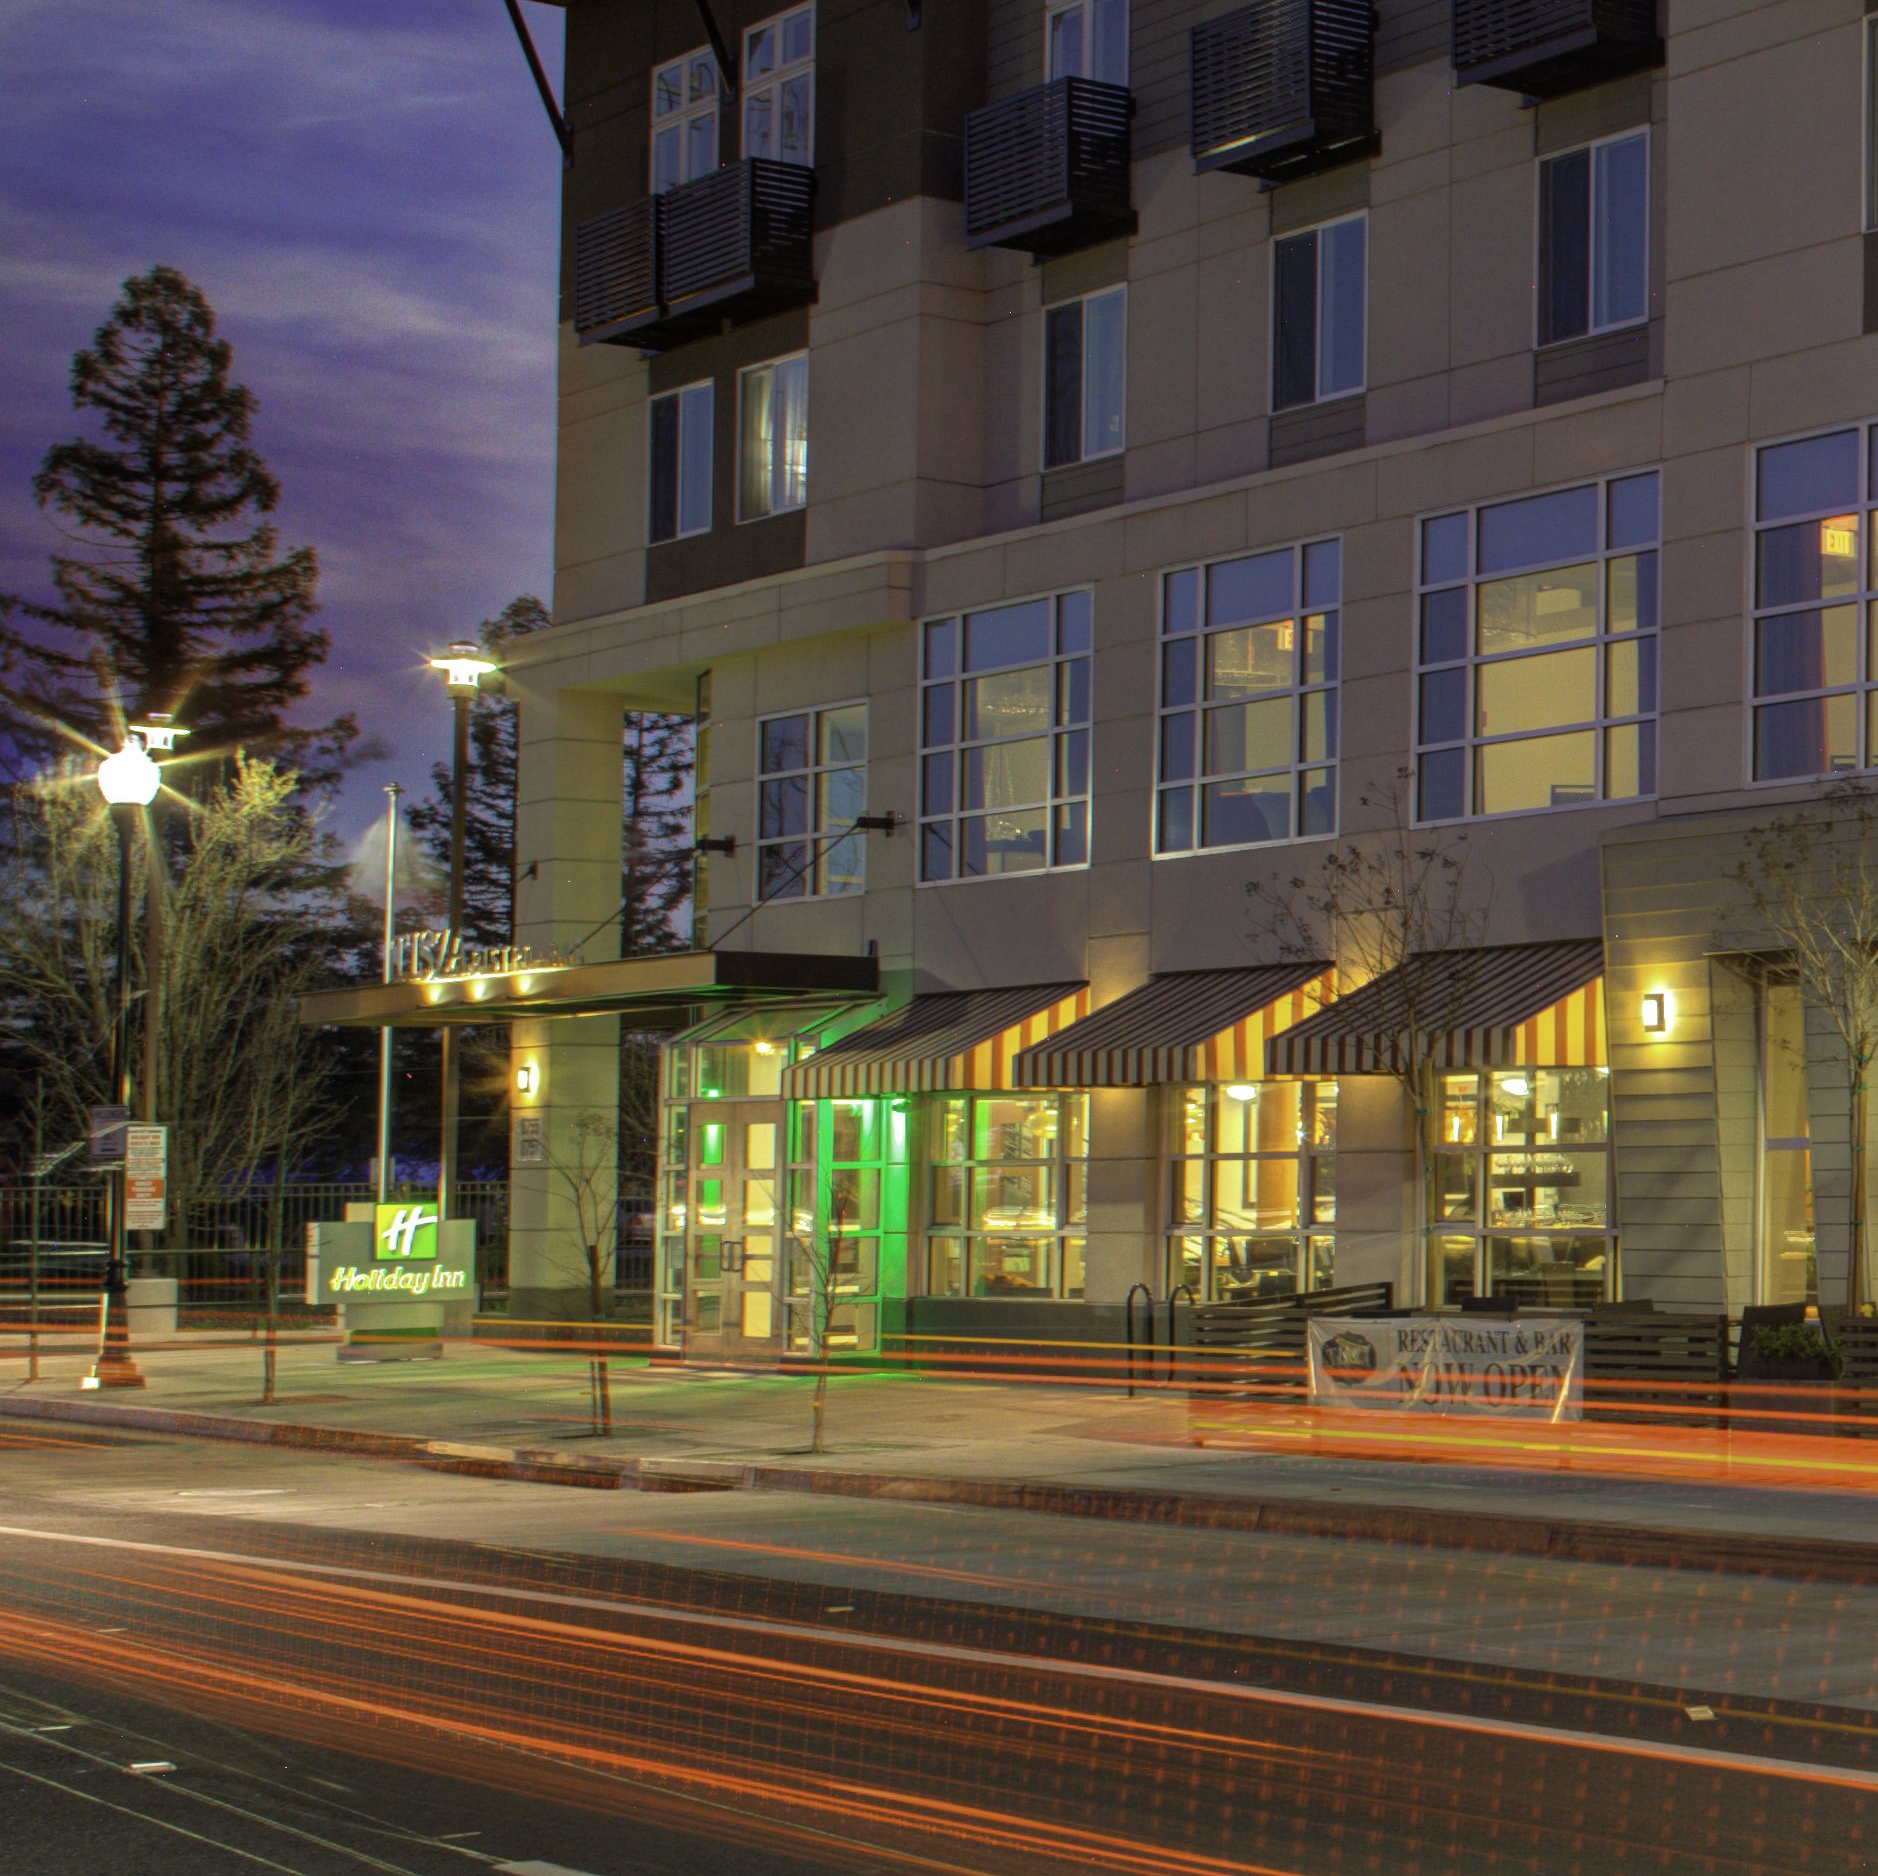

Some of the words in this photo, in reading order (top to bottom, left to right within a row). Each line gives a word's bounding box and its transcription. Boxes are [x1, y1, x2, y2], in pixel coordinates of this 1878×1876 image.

[330, 1266, 428, 1294] Holiday
[431, 1264, 465, 1289] Inn
[1397, 1329, 1511, 1355] RESTAURANT
[1515, 1330, 1529, 1355] &
[1534, 1331, 1572, 1356] BAR
[1396, 1360, 1475, 1406] NOW
[1483, 1361, 1570, 1408] OPEN
